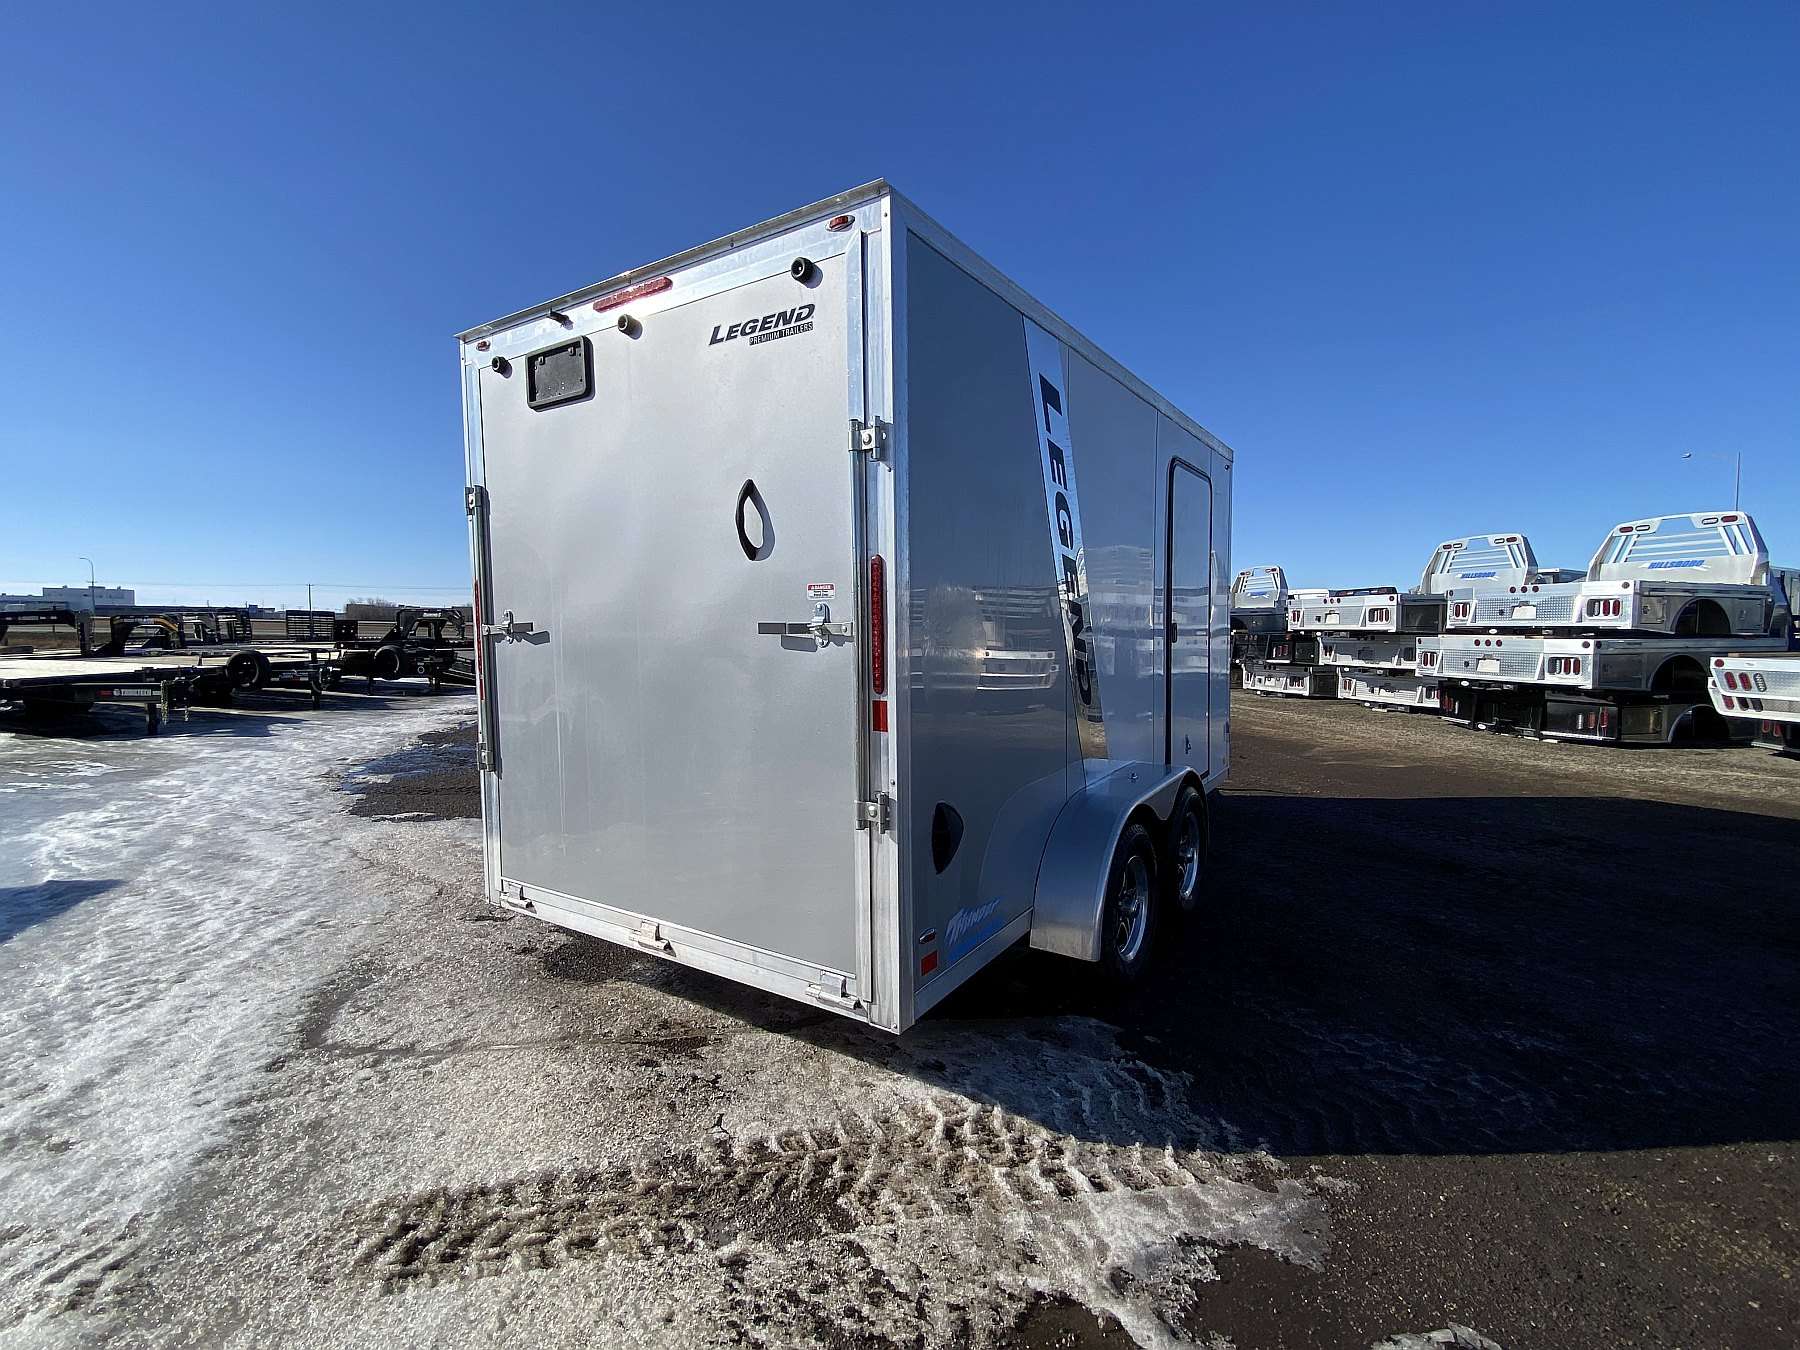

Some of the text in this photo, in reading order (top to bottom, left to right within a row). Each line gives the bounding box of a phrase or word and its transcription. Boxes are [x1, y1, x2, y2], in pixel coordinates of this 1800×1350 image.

[709, 303, 815, 345] LEGEND
[749, 321, 813, 345] PREMIUM TRAILERS
[1038, 372, 1092, 706] LEGEND
[1648, 560, 1705, 569] HILLSBORO
